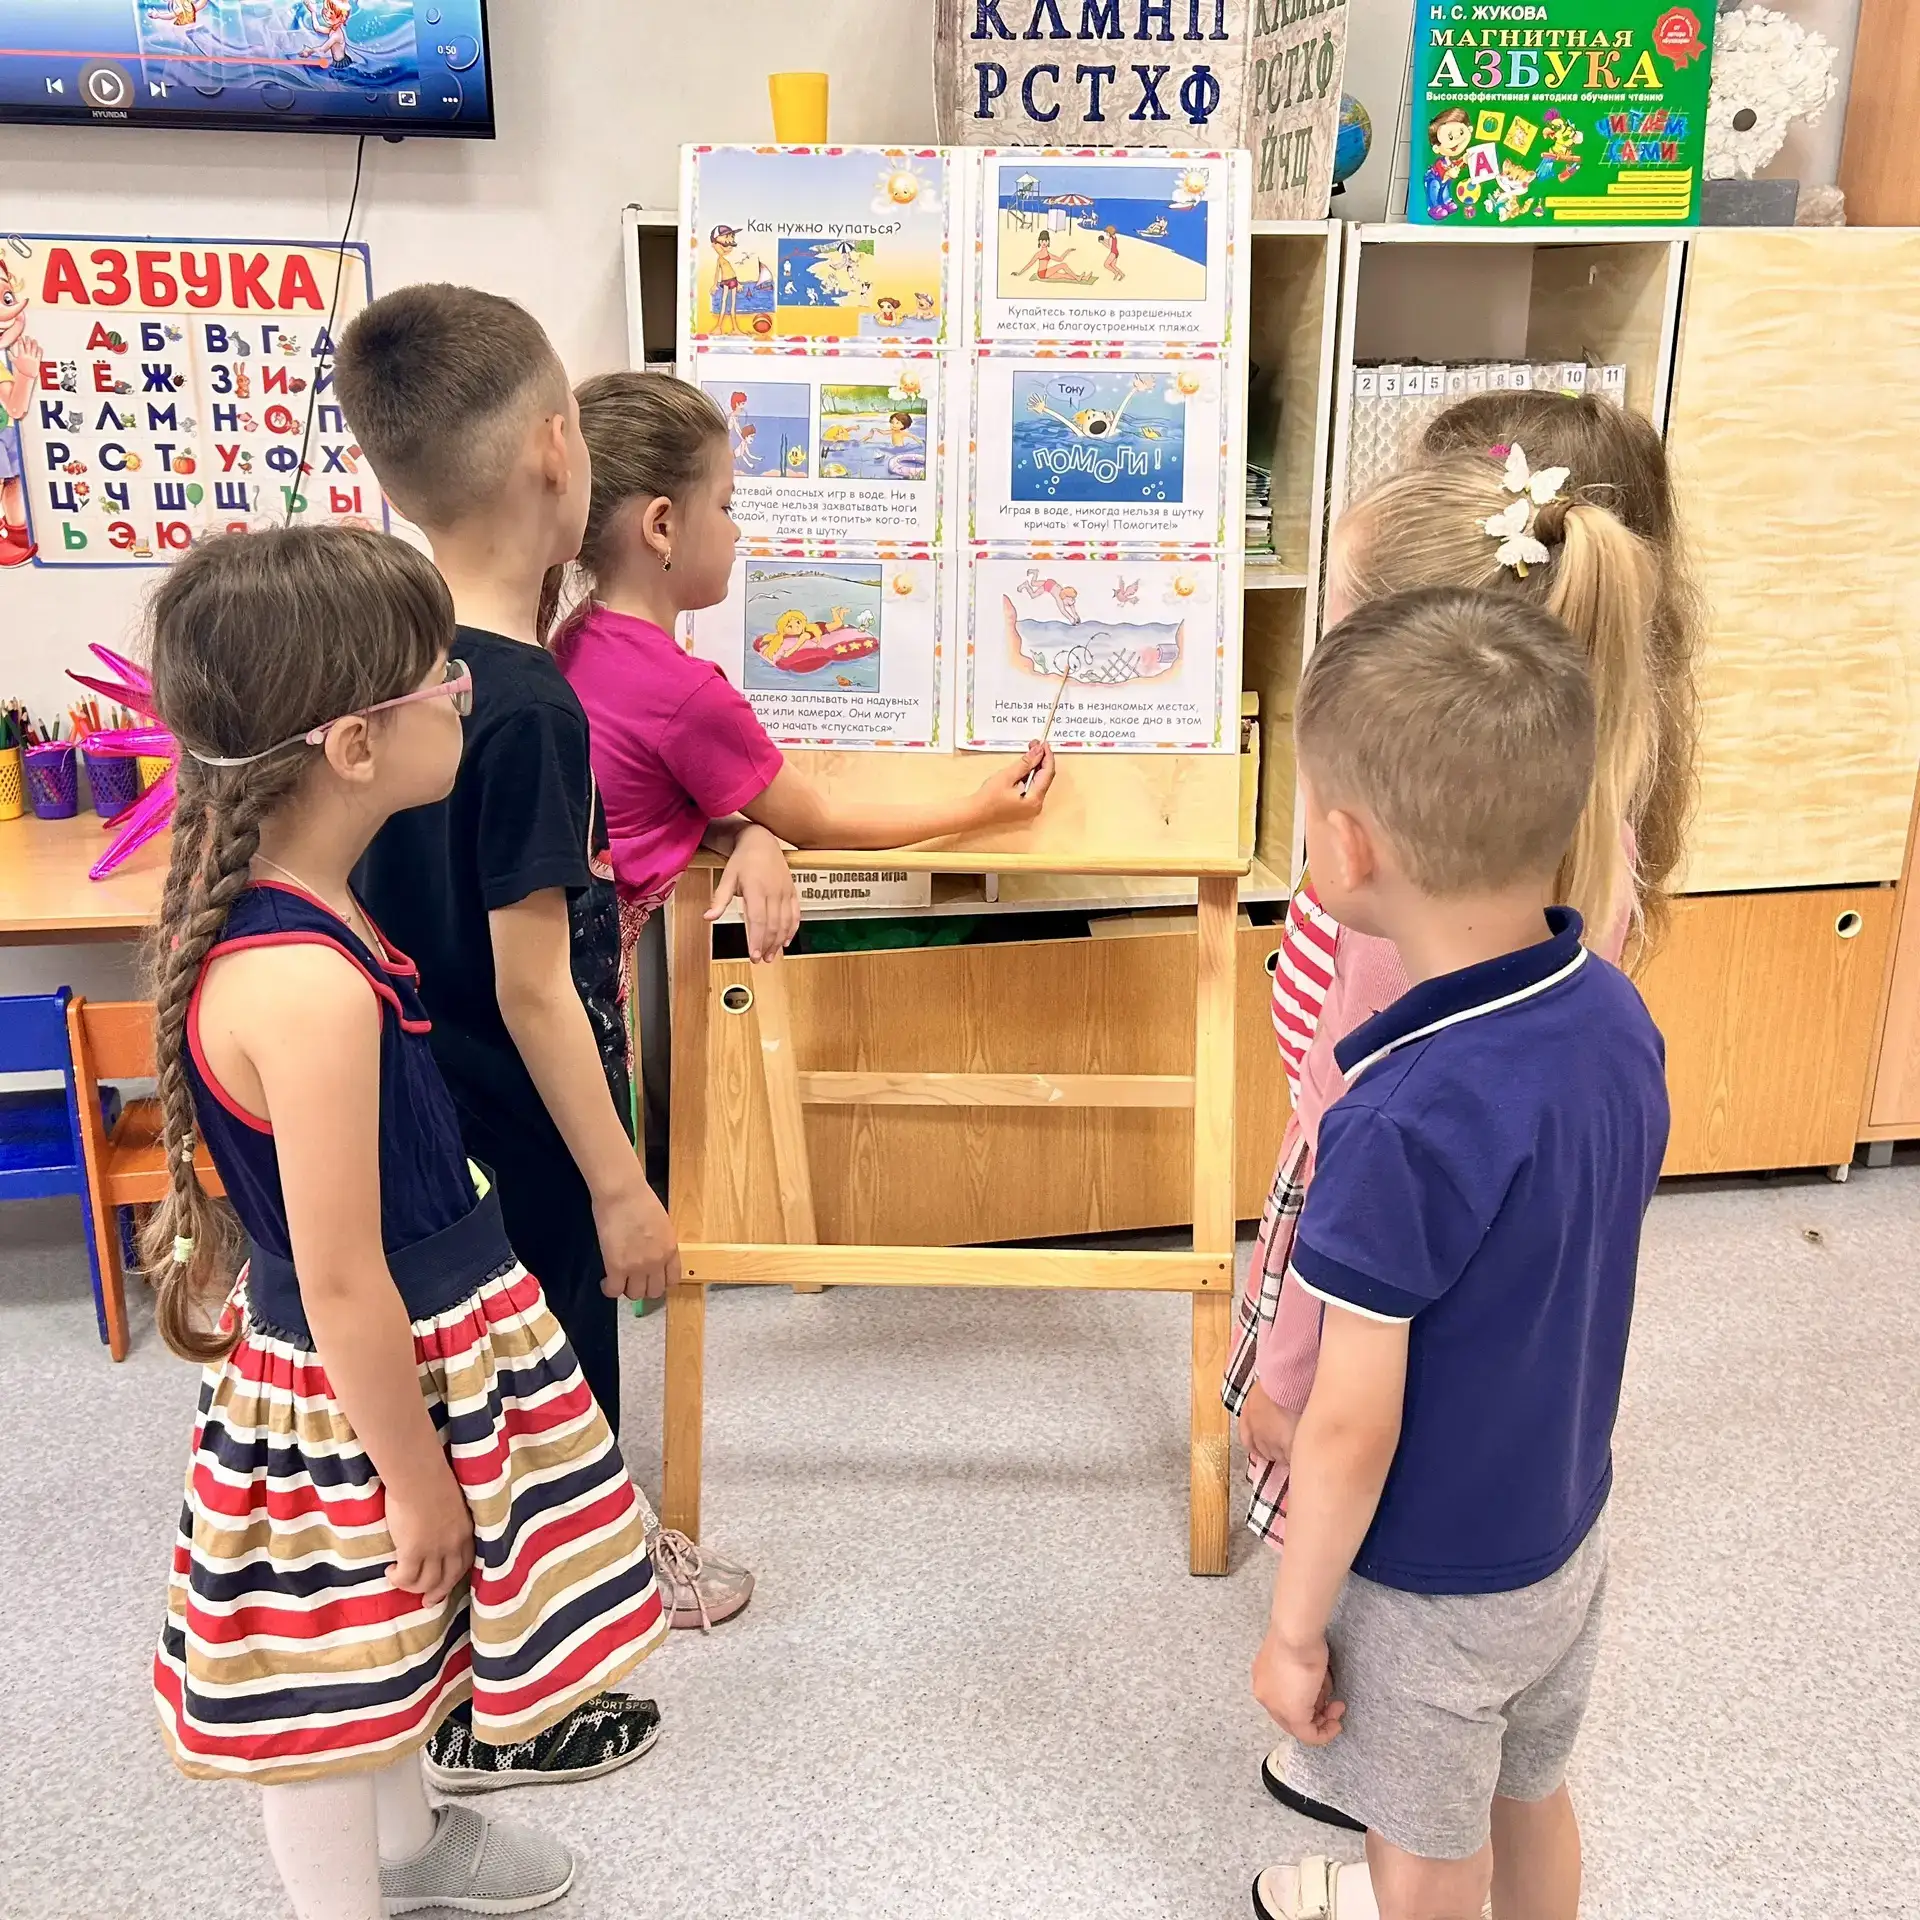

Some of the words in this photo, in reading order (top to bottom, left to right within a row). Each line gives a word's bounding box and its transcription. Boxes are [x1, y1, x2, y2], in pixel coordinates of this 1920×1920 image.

[1430, 6, 1446, 20] Н.
[1451, 6, 1467, 20] С.
[1472, 6, 1548, 20] ЖУКОВА
[1429, 28, 1634, 48] МАГНИТНАЯ
[1427, 49, 1664, 89] АЗБУКА
[1426, 92, 1529, 104] Высокоэффективная
[1532, 93, 1577, 102] методика
[1581, 92, 1625, 103] обучения
[1628, 93, 1663, 102] чтению
[92, 110, 128, 118] HYUNDAI
[1609, 139, 1677, 161] САМИ
[1475, 152, 1494, 177] А
[747, 219, 773, 233] Как
[777, 222, 823, 237] нужно
[828, 222, 901, 238] купаться?
[42, 248, 325, 310] АЗБУКА
[1008, 305, 1065, 318] Купайтесь
[1068, 308, 1106, 317] только
[1109, 309, 1115, 317] в
[1119, 309, 1192, 319] разрешенных
[1042, 322, 1055, 331] на
[1058, 321, 1155, 333] благоустроенных
[86, 321, 111, 350] А
[140, 322, 165, 351] Б
[205, 323, 229, 353] В
[261, 325, 279, 353] Г
[40, 361, 58, 391] Е
[93, 360, 114, 392] Ё
[141, 363, 177, 393] Ж
[212, 364, 232, 394] З
[262, 365, 288, 395] И
[1473, 376, 1481, 388] 7
[1497, 375, 1504, 387] 8
[1516, 374, 1524, 386] 9
[1567, 370, 1582, 382] 10
[1607, 370, 1618, 382] 11
[1363, 378, 1371, 390] 2
[1387, 379, 1395, 391] 3
[1408, 377, 1417, 389] 4
[1430, 377, 1438, 389] 5
[1452, 377, 1460, 389] 6
[1058, 383, 1085, 396] Тону
[40, 400, 67, 429] К
[95, 401, 125, 430] Л
[147, 402, 177, 431] М
[213, 403, 238, 432] Н
[264, 404, 293, 434] О
[318, 405, 343, 433] П
[46, 442, 70, 471] Р
[99, 442, 127, 472] С
[154, 444, 176, 472] Т
[215, 444, 241, 472] У
[264, 444, 298, 474] Ф
[322, 445, 348, 474] Х
[48, 482, 79, 513] Ц
[104, 482, 130, 510] Ч
[154, 483, 187, 510] Ш
[214, 482, 250, 513] Щ
[329, 486, 363, 514] Ы
[776, 489, 824, 497] опасных
[827, 489, 846, 500] игр
[850, 491, 856, 499] в
[891, 489, 906, 500] Ни
[910, 491, 916, 500] в
[741, 500, 779, 511] случае
[782, 501, 819, 511] нельзя
[822, 502, 888, 512] захватывать
[891, 504, 917, 513] ноги
[999, 504, 1031, 517] Играя
[1034, 507, 1040, 515] в
[1044, 507, 1072, 516] воде,
[1076, 507, 1120, 517] никогда
[1123, 508, 1160, 516] нельзя
[1163, 508, 1169, 516] в
[1172, 509, 1204, 519] шутку
[772, 514, 807, 525] пугать
[810, 515, 818, 523] и
[62, 522, 88, 550] Ь
[107, 521, 136, 549] Э
[156, 522, 192, 550] Ю
[776, 526, 804, 536] даже
[807, 527, 813, 536] в
[816, 528, 848, 538] шутку
[749, 694, 788, 703] далеко
[791, 695, 848, 705] заплывать
[851, 697, 864, 705] на
[867, 697, 919, 708] надувных
[995, 700, 1033, 711] Нельзя
[1037, 702, 1075, 710] ныять
[1079, 702, 1084, 711] в
[1087, 702, 1153, 712] незнакомых
[849, 709, 871, 719] Они
[874, 711, 906, 722] могут
[991, 715, 1009, 724] так
[1012, 715, 1028, 724] как
[1032, 716, 1046, 724] ты
[1110, 716, 1139, 725] какое
[1143, 716, 1163, 726] дно
[1166, 717, 1172, 725] в
[1176, 716, 1202, 725] этом
[782, 723, 818, 731] начать
[1053, 730, 1086, 738] месте
[791, 872, 817, 882] етно
[829, 872, 879, 883] ролевая
[881, 871, 908, 882] игра
[802, 887, 871, 900] «Водитель»
[588, 1698, 624, 1710] SPORT
